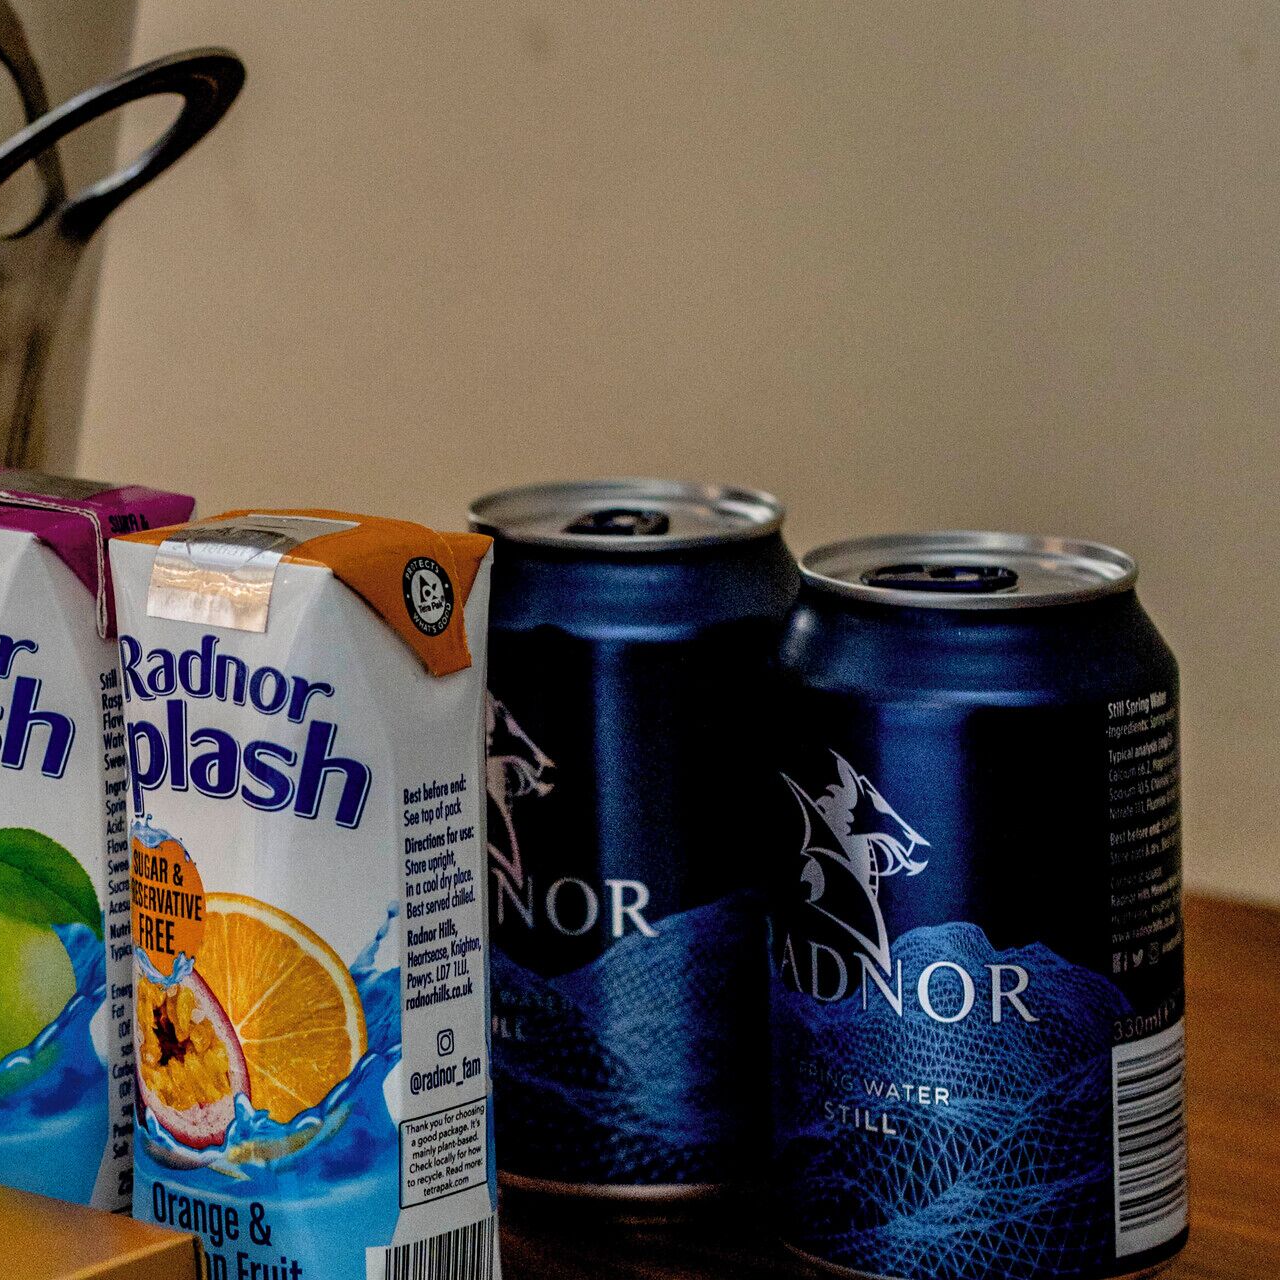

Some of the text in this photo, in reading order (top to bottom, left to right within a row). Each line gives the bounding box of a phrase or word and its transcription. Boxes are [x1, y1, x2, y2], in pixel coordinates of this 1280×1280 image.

[405, 559, 439, 580] PROTECTS
[438, 602, 452, 630] GOOD
[100, 669, 117, 690] Still
[119, 634, 334, 723] Radnor
[102, 693, 123, 711] Rasp
[1108, 700, 1124, 719] Still
[1126, 697, 1150, 718] Spring
[126, 698, 371, 830] plash
[105, 780, 126, 796] Ingre
[404, 773, 467, 805] Best before end:
[106, 799, 126, 817] Sprin
[404, 797, 462, 827] See top of pack
[107, 839, 128, 855] Flavo
[405, 826, 474, 854] Directions for use:
[108, 860, 129, 875] Swee
[133, 848, 184, 887] SUGAR &
[405, 849, 457, 877] Store upright,
[406, 869, 474, 898] in a cool dry place.
[109, 901, 131, 916] Acesu
[406, 885, 476, 920] Best served chilled.
[490, 866, 660, 937] NOR
[110, 921, 130, 939] Nutri
[139, 913, 175, 955] FREE
[407, 919, 458, 947] Radnor Hills,
[407, 936, 482, 969] Heartsease, Knighton,
[407, 958, 470, 990] Powys. LD7 1LU.
[780, 931, 1040, 1024] ADNOR
[111, 983, 132, 999] Energ
[406, 977, 473, 1011] radnorhills.co.uk
[410, 1056, 481, 1095] @radnor_fam
[864, 1078, 950, 1107] WATER
[406, 1105, 485, 1134] Thank you for choosing
[411, 1119, 480, 1147] a good package. It's
[824, 1101, 897, 1136] STILL
[409, 1145, 482, 1174] Check locally for how
[412, 1131, 479, 1160] mainly plant-based.
[407, 1158, 483, 1187] to recycle. Read more:
[423, 1176, 470, 1197] tetrapak.com
[152, 1181, 240, 1248] Orange
[249, 1202, 272, 1246] &
